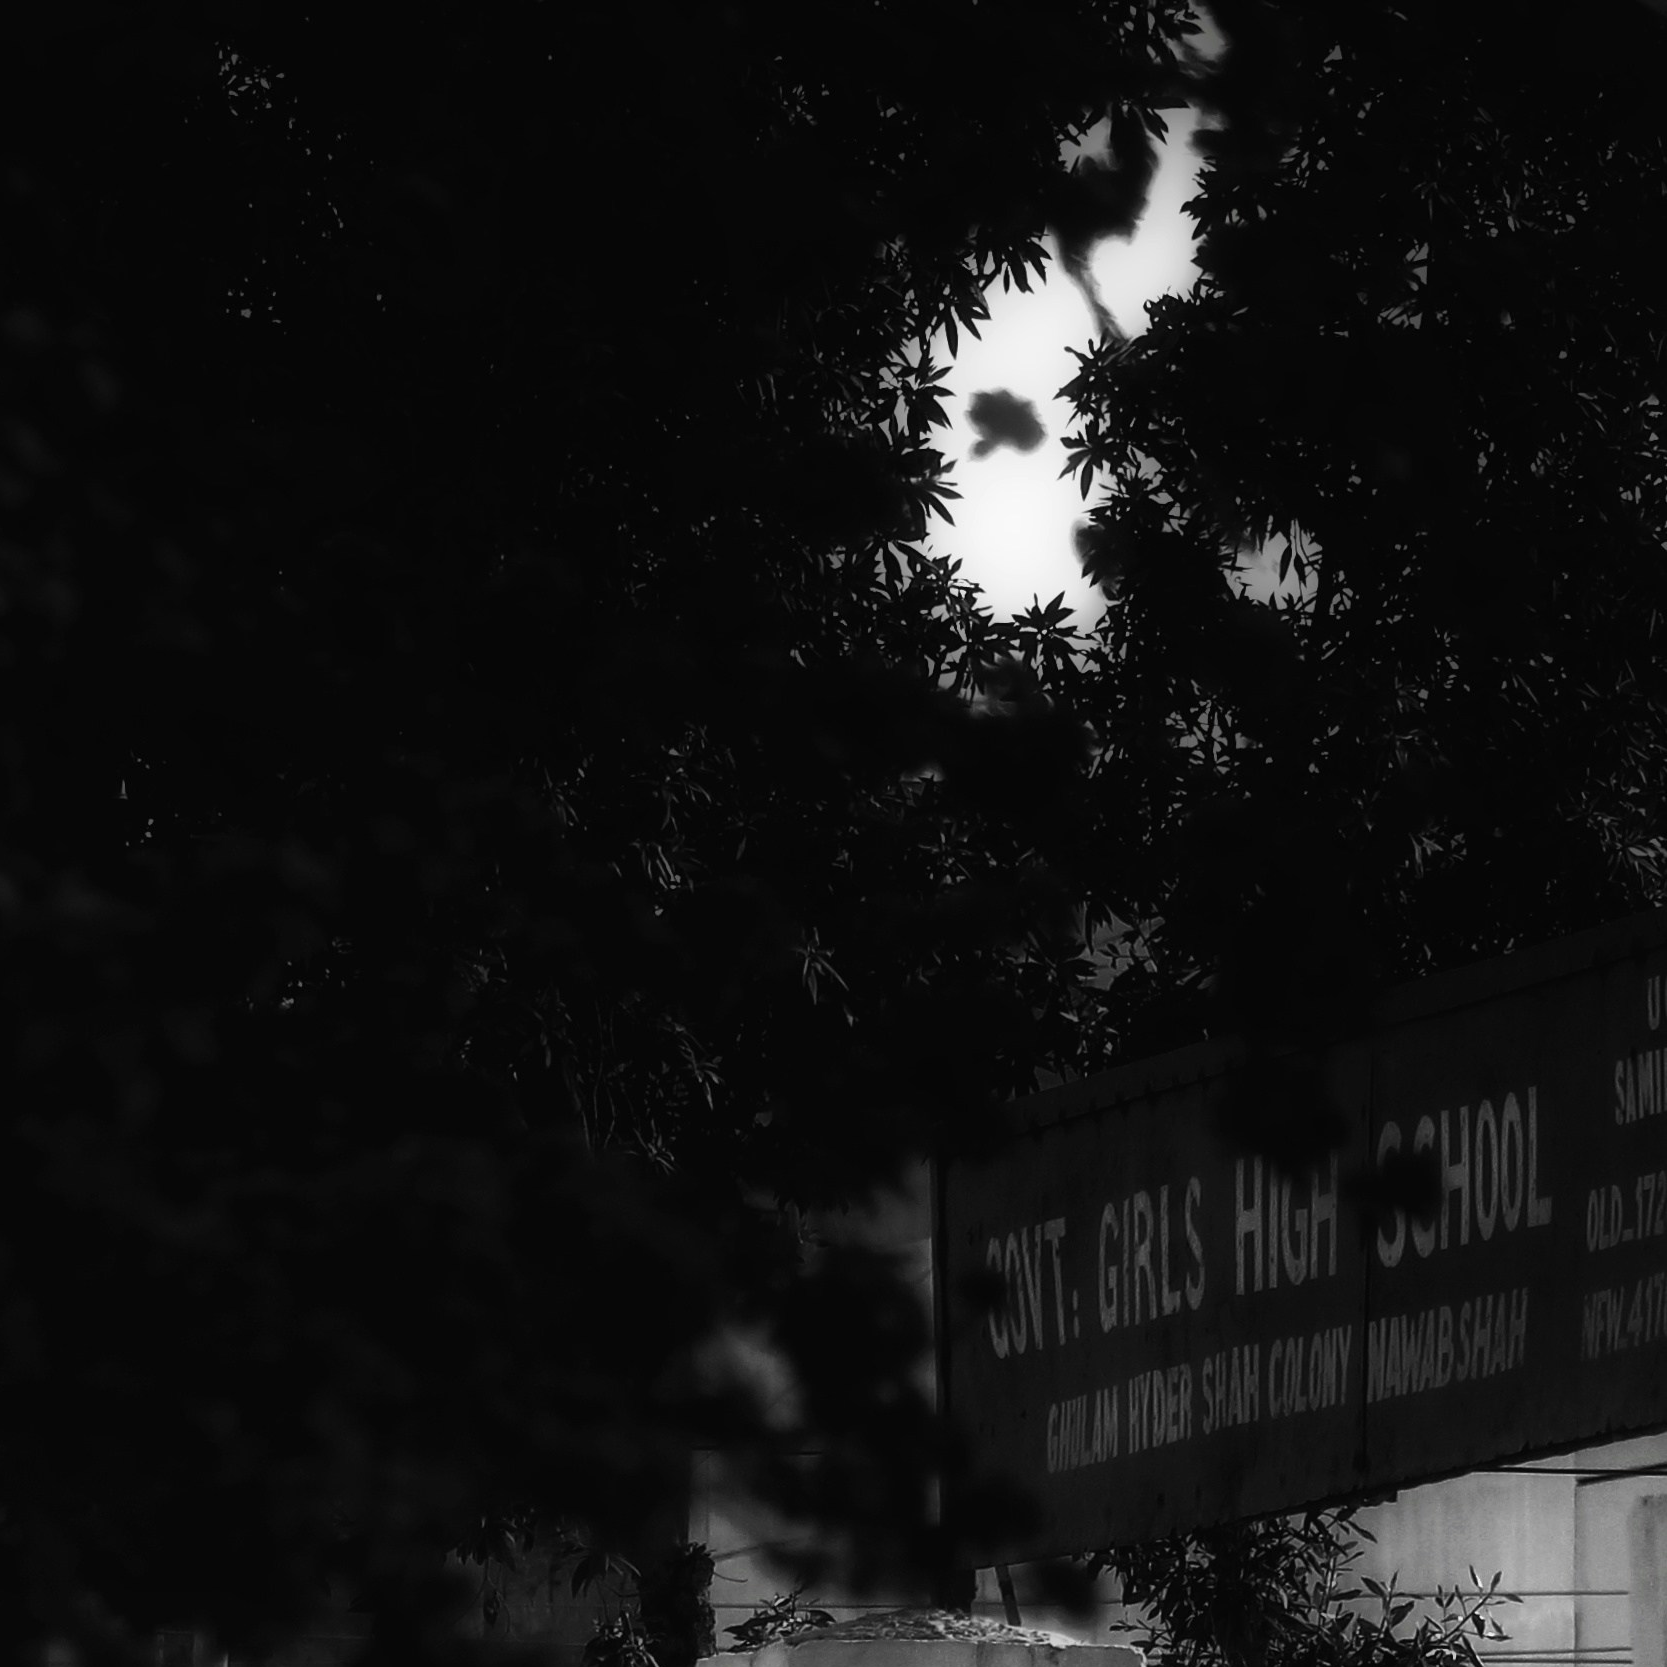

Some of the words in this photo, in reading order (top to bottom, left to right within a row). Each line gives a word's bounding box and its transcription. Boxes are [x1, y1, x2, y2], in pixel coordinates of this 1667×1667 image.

[1648, 975, 1667, 1030] U
[1098, 1176, 1206, 1333] GIRLS
[1235, 1147, 1339, 1296] HIGH
[1376, 1086, 1552, 1268] SCHOOL
[1128, 1363, 1192, 1454] HYDER
[1202, 1343, 1260, 1435] SHAH
[1268, 1324, 1352, 1418] COLONY
